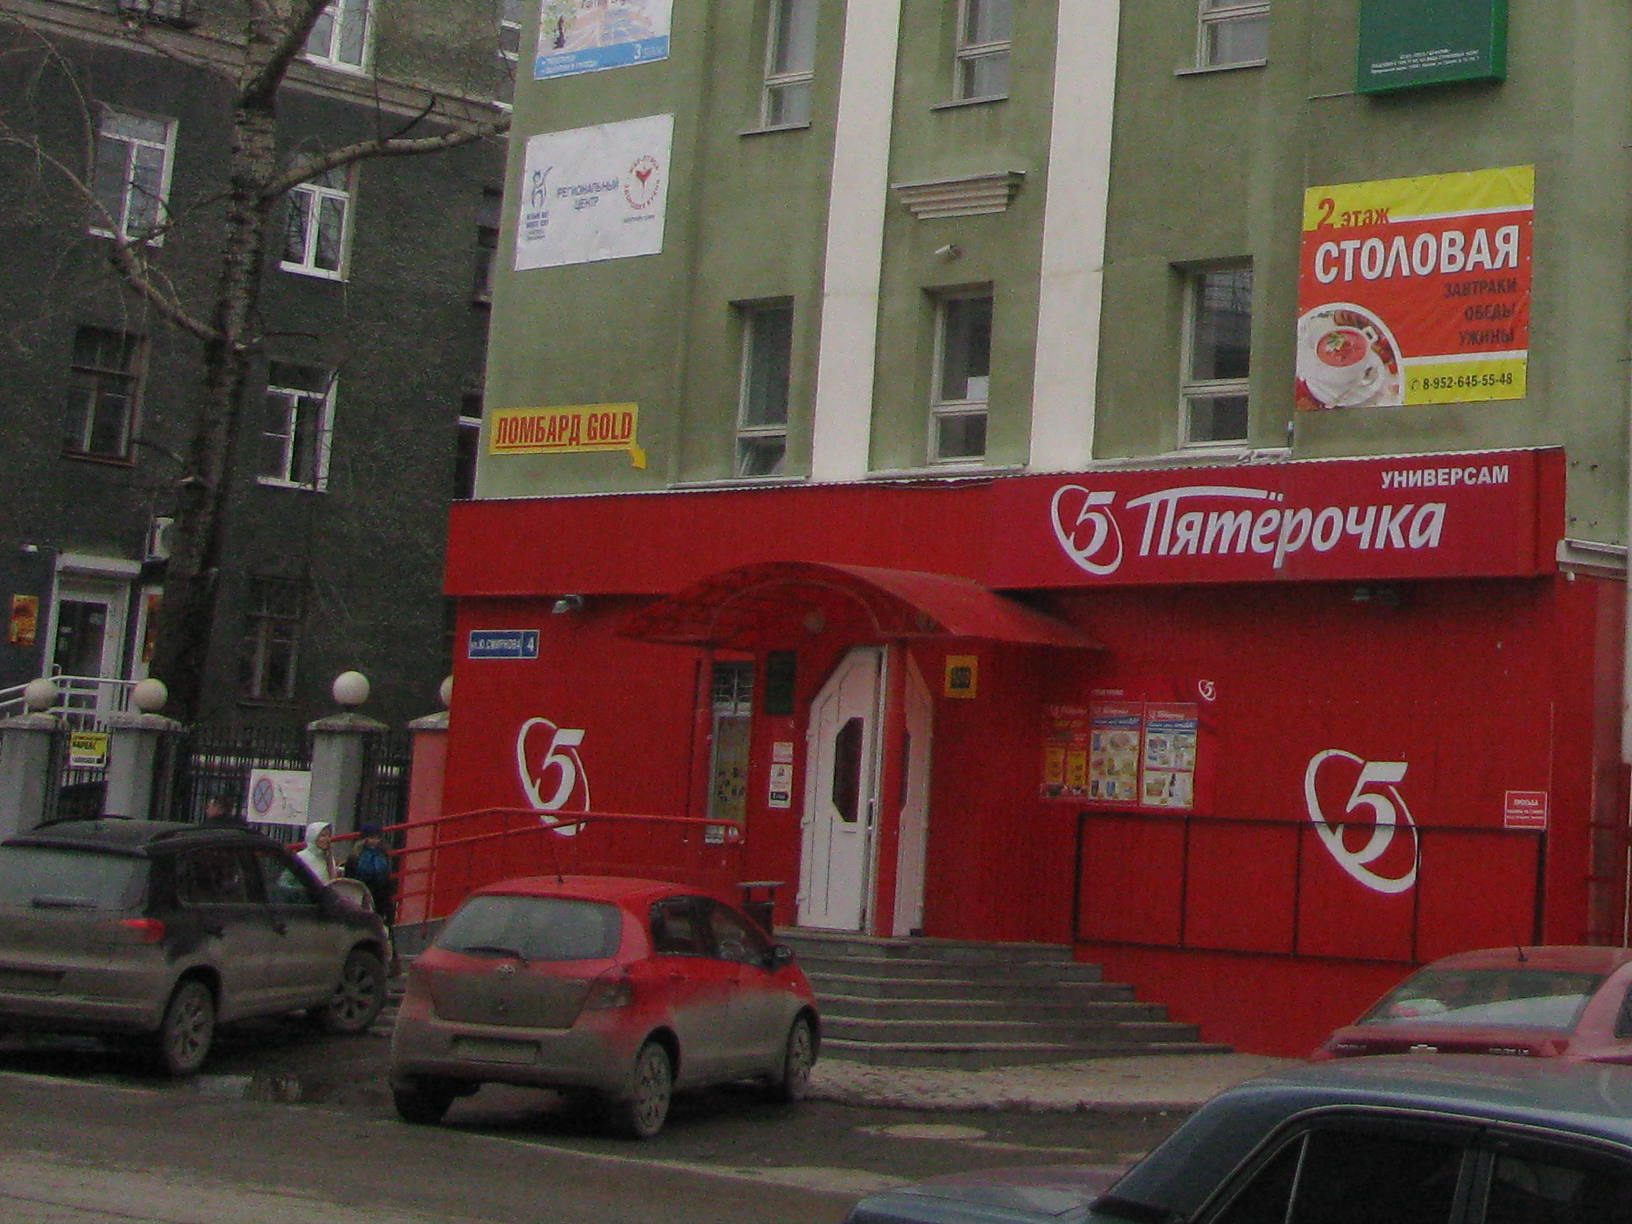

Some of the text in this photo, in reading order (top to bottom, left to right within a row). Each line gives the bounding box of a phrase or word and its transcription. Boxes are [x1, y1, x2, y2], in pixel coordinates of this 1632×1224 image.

[1316, 197, 1392, 230] 2 этаж
[1315, 225, 1520, 284] СТОЛОВАЯ
[1443, 277, 1517, 298] ЗАВТРАКИ
[1464, 303, 1515, 321] ОБЕДЫ
[1459, 327, 1514, 346] УЖИНЫ
[495, 412, 634, 447] ЛОМБАРД GOLD
[1381, 464, 1510, 490] УНИВЕРСАМ
[1125, 484, 1447, 569] Пятёрочка
[527, 635, 536, 652] 4
